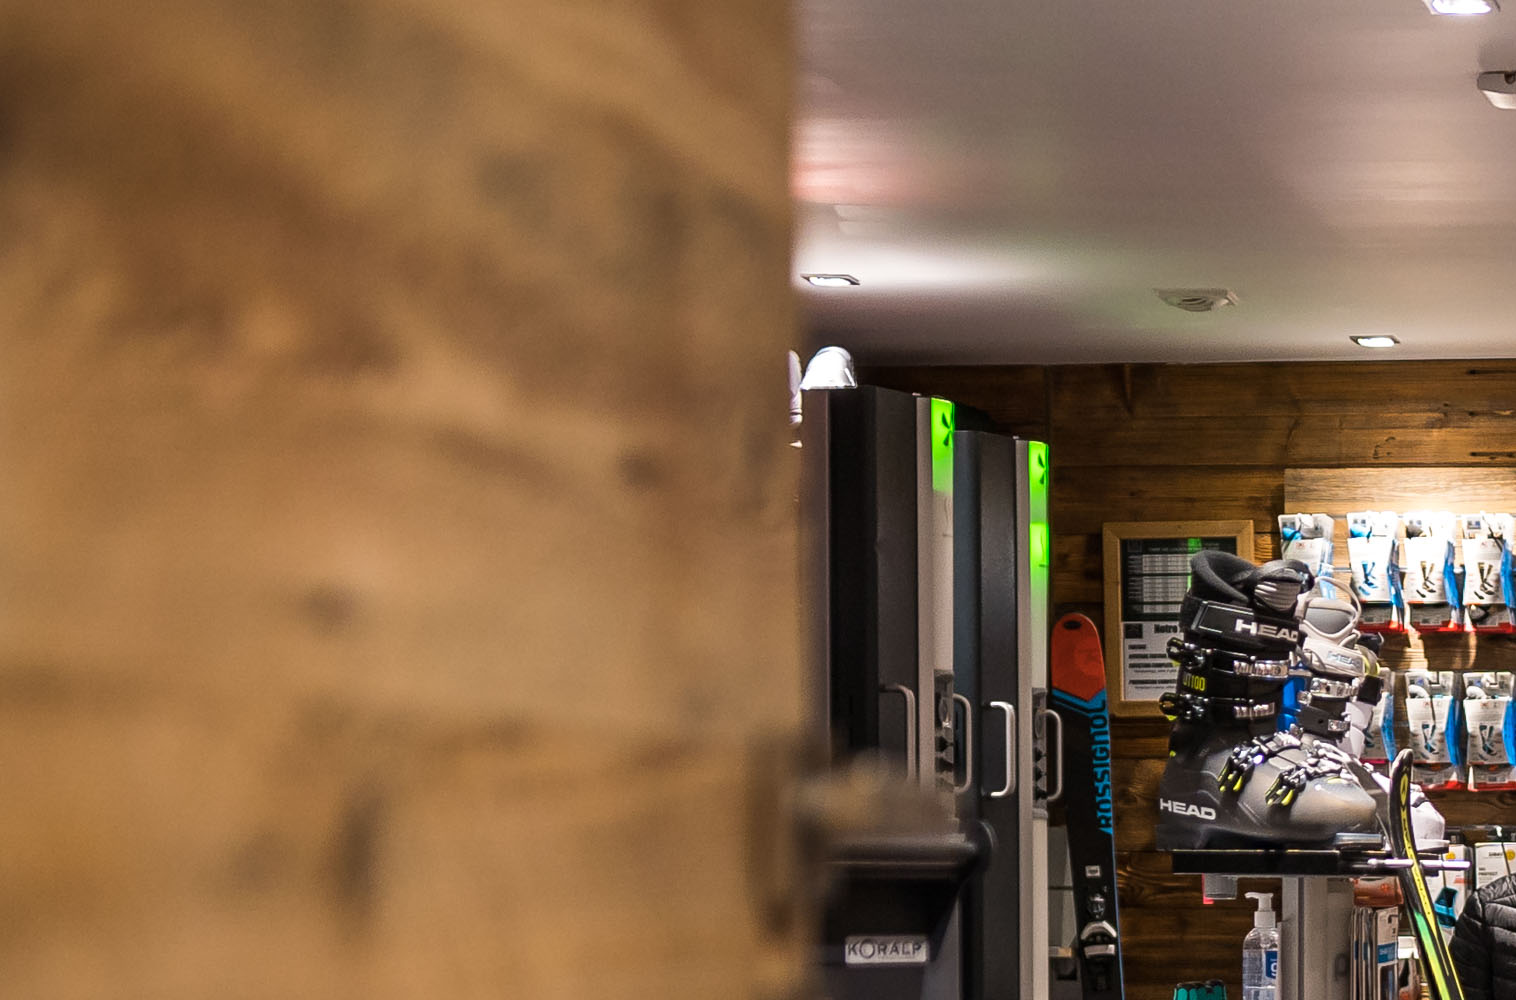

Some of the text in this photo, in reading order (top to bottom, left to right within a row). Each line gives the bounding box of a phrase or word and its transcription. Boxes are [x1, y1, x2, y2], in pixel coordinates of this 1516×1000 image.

[1235, 618, 1299, 641] HEAD
[1159, 798, 1217, 820] HEAD
[847, 938, 922, 959] KORALP
